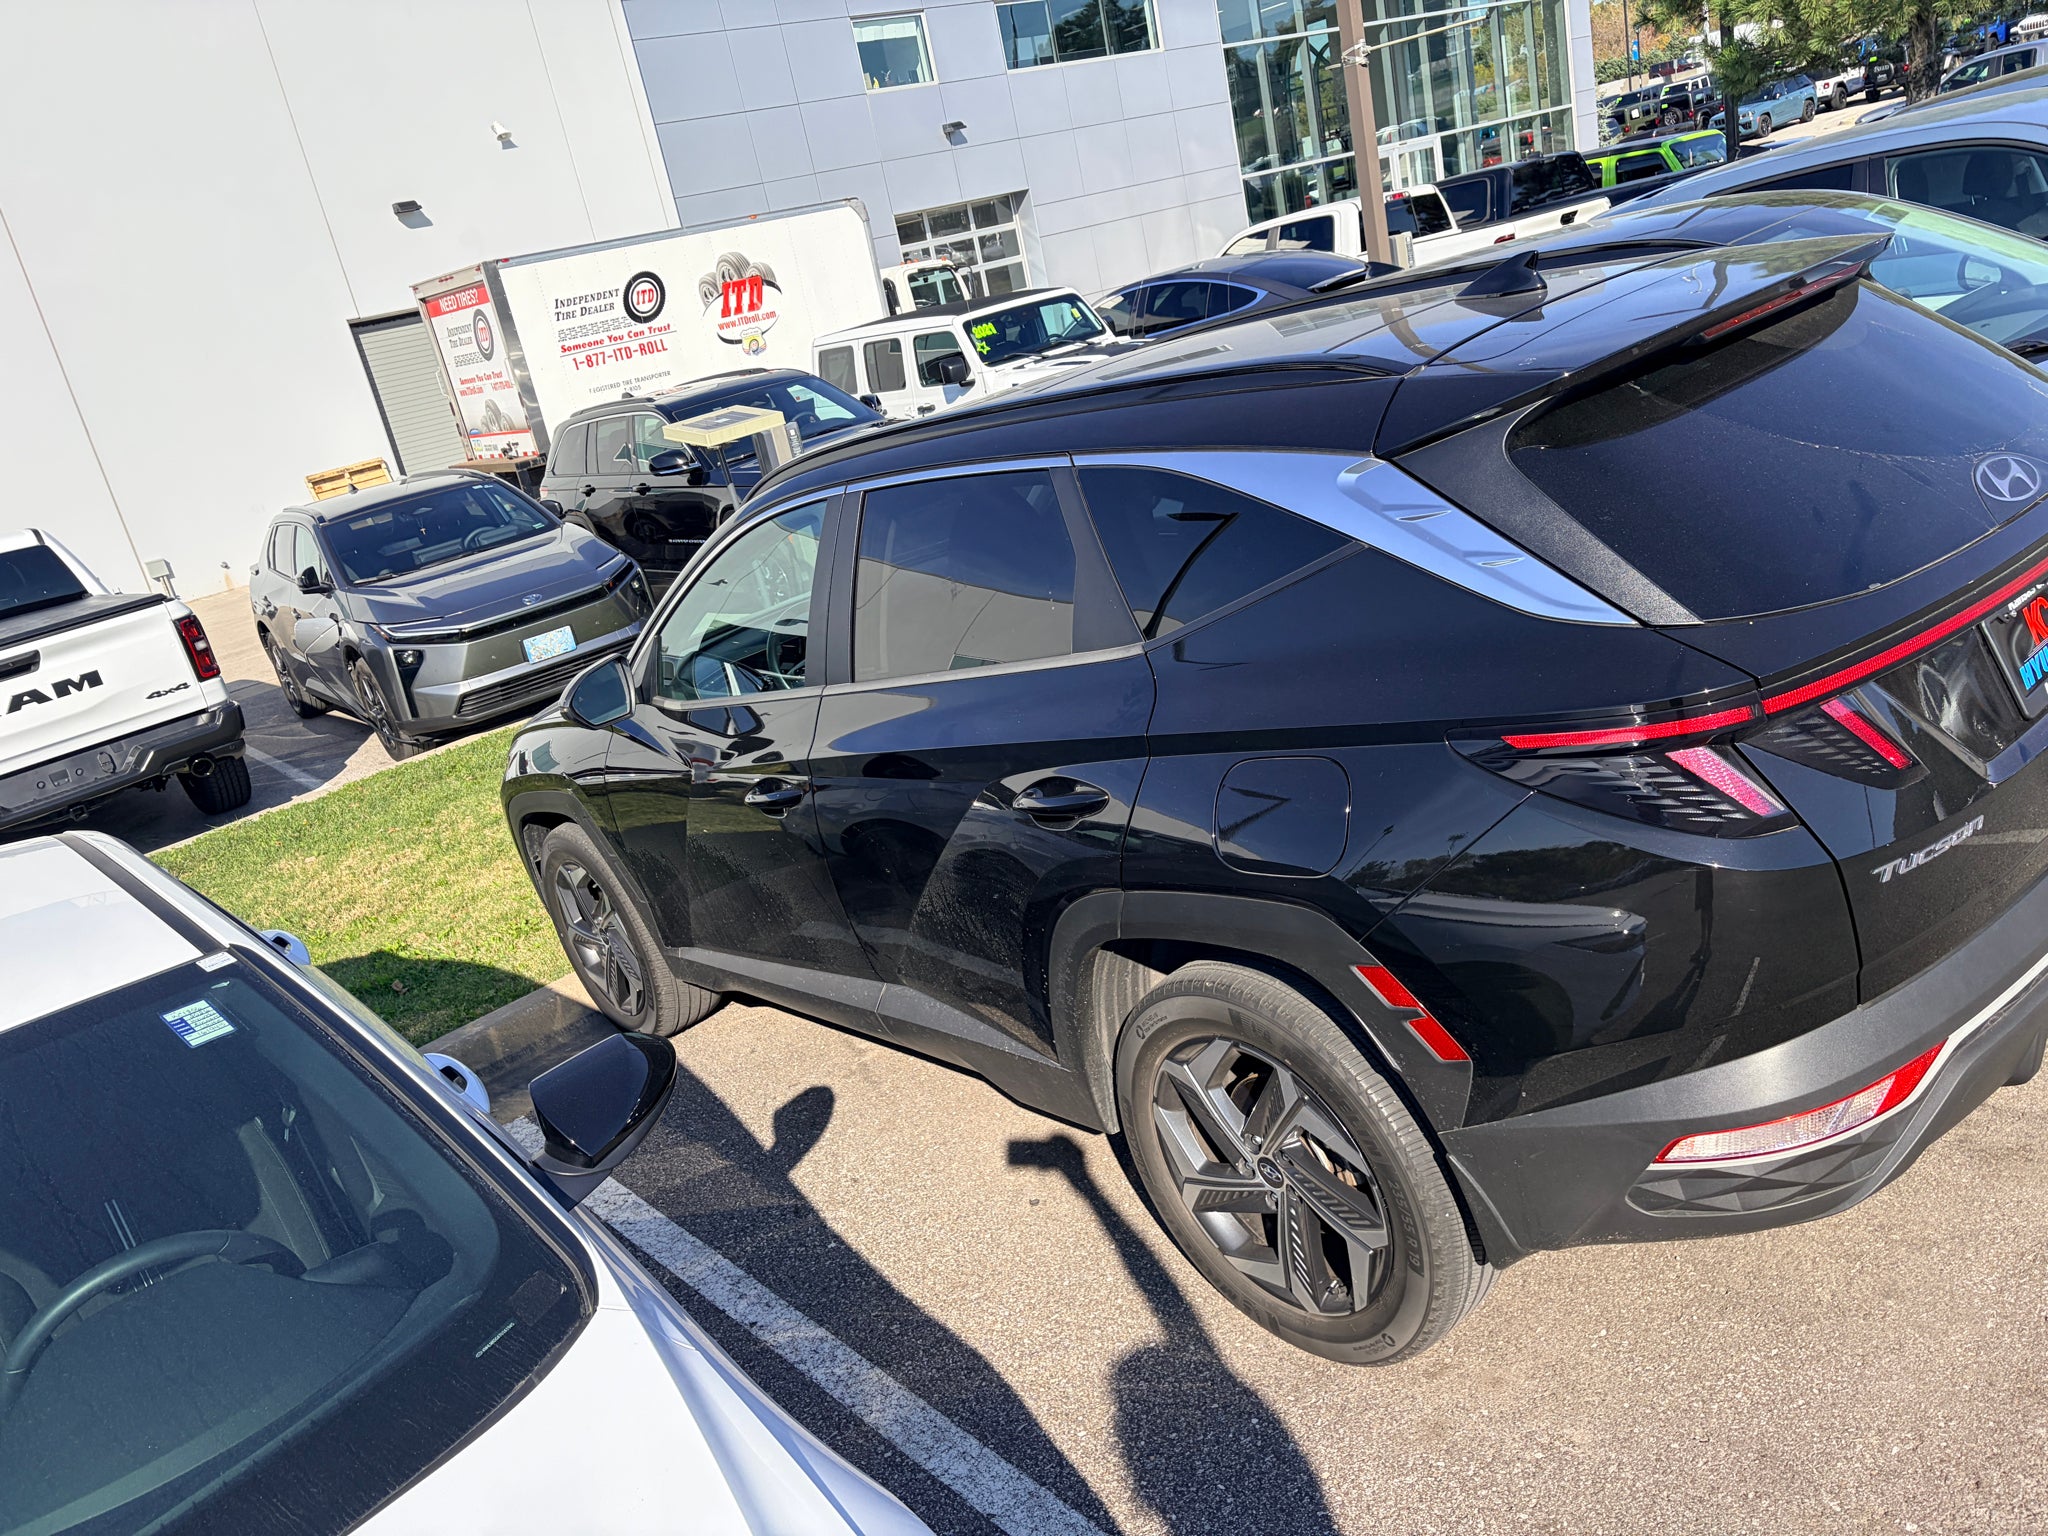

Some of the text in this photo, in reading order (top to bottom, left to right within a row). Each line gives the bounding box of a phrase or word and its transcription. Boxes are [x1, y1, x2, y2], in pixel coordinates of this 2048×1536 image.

[438, 288, 479, 312] NEED TIRES?
[554, 288, 620, 309] INDEPENDENT
[636, 287, 655, 306] ITD
[721, 274, 763, 319] ITD
[554, 302, 615, 322] TIRE DEALER
[717, 310, 777, 331] www.ITDroll.com
[561, 323, 671, 353] Someone You Can Trust
[971, 322, 998, 339] 2021
[572, 338, 668, 371] 1-877-ITD-ROLL
[0, 669, 104, 717] AM
[1388, 1179, 1421, 1269] 235/55 R 19
